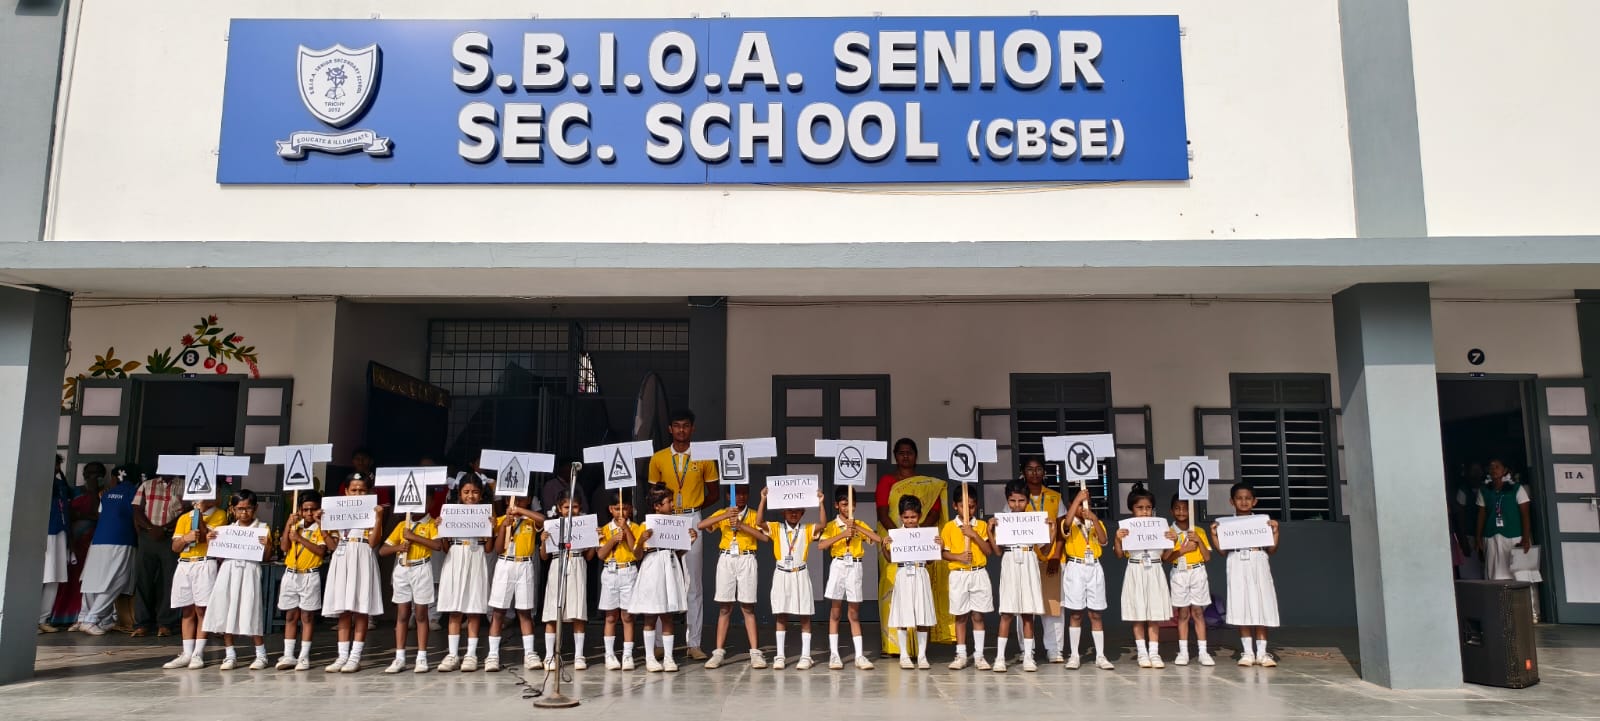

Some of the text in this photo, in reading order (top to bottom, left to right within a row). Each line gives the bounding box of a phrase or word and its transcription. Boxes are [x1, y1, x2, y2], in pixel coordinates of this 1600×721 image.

[451, 30, 1104, 91] S.B.I.O.A. SENIOR
[458, 101, 1126, 162] SEC. SCHOOL (CBSE)
[296, 136, 326, 145] EDUCATE
[333, 132, 370, 145] ILLUMINATE
[186, 353, 196, 364] 8
[1471, 353, 1481, 363] 7
[1576, 471, 1584, 479] A
[774, 478, 812, 487] HOSPITAL
[784, 492, 805, 500] ZONE
[336, 499, 363, 508] SPEED
[330, 513, 370, 521] BREAKER
[1002, 515, 1041, 524] NO RIGHT
[445, 521, 486, 529] CROSSING
[655, 518, 686, 527] SLIPPERY
[1129, 520, 1142, 528] NO
[225, 529, 255, 538] UNDER
[659, 532, 680, 540] ROAD
[909, 531, 921, 539] NO
[1235, 528, 1267, 536] PARKING
[1137, 534, 1158, 542] TURN
[210, 541, 263, 551] CONSTRUCTION
[892, 544, 940, 552] OVERTAKING
